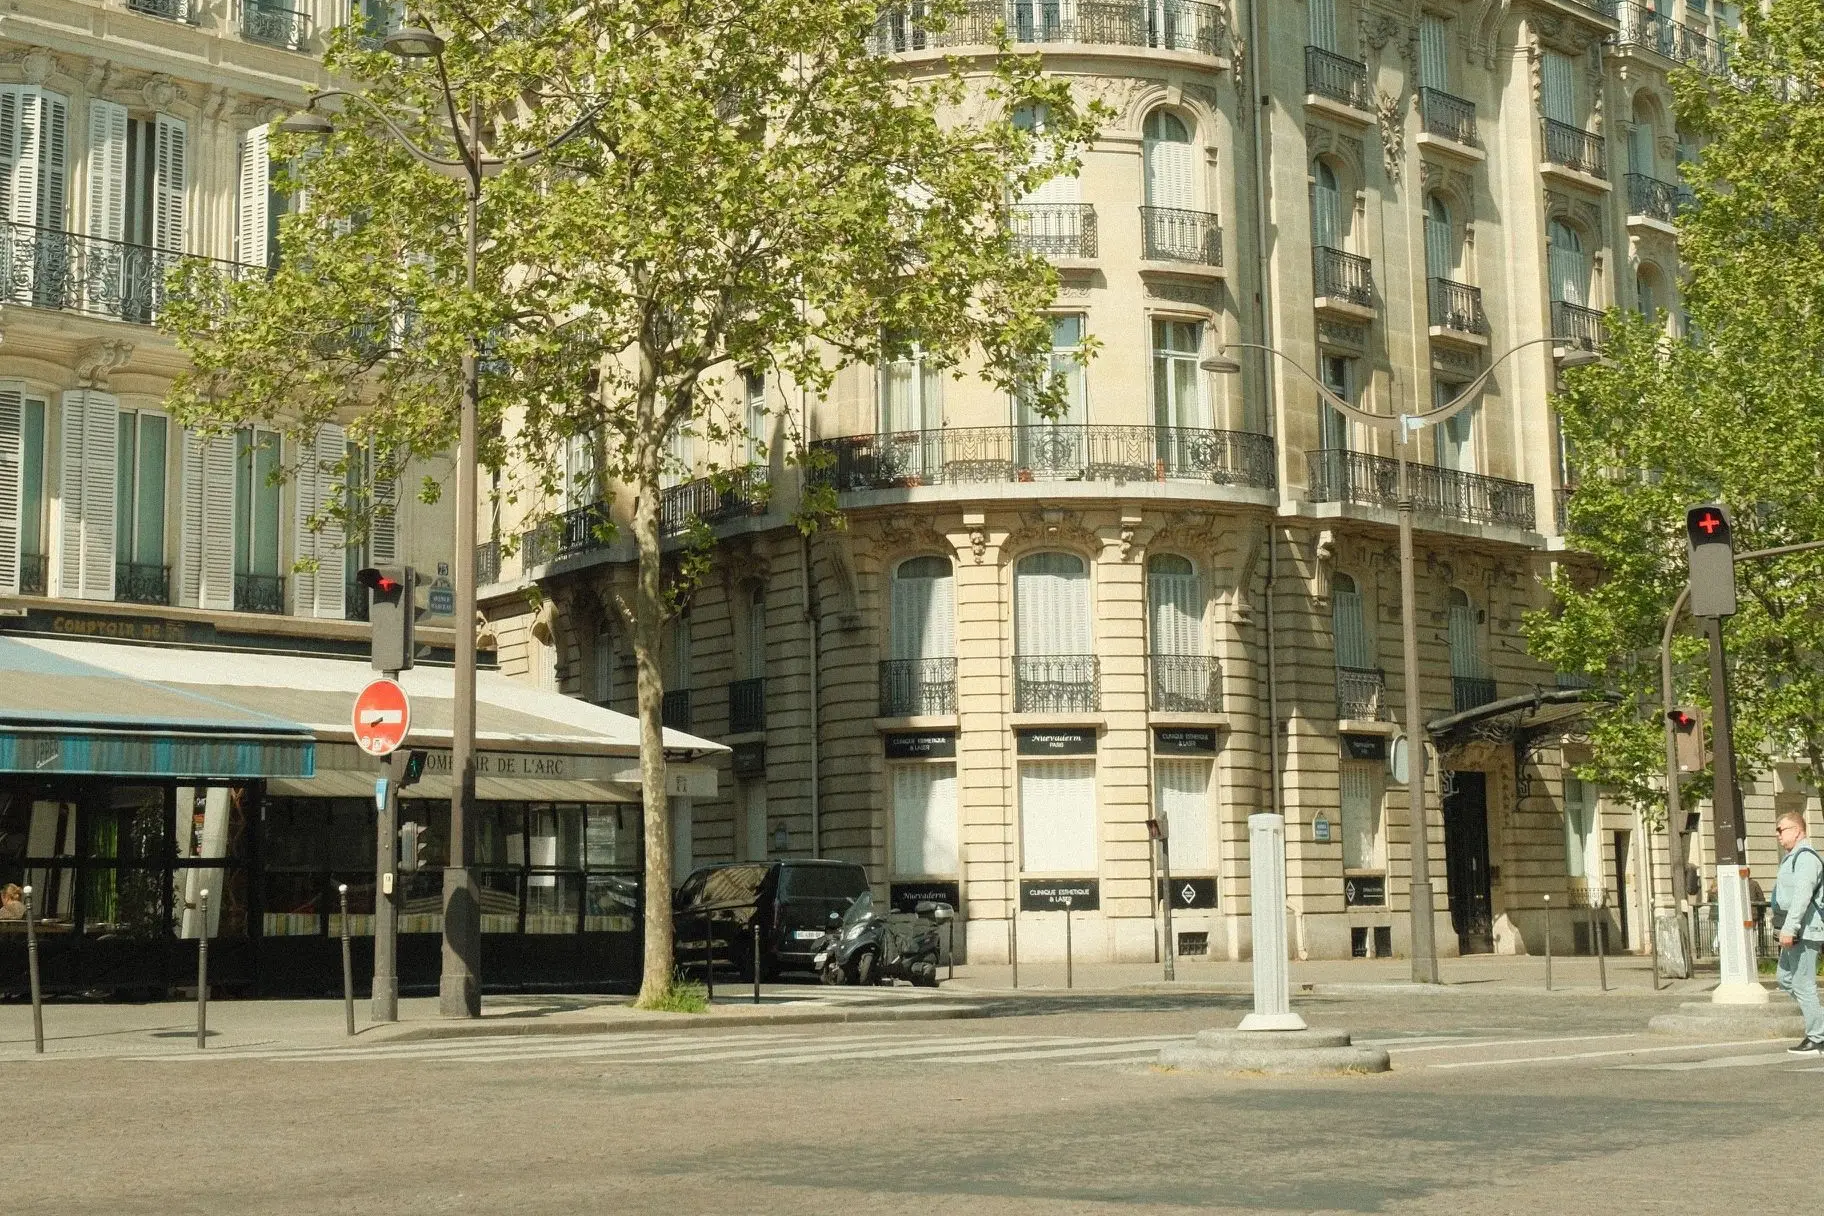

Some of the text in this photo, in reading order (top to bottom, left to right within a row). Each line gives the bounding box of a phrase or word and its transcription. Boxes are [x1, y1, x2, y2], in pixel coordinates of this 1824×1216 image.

[53, 616, 134, 638] COMPTOIR
[1031, 733, 1082, 742] Nuevaderm
[498, 758, 516, 773] DE
[523, 758, 564, 775] L'ARC
